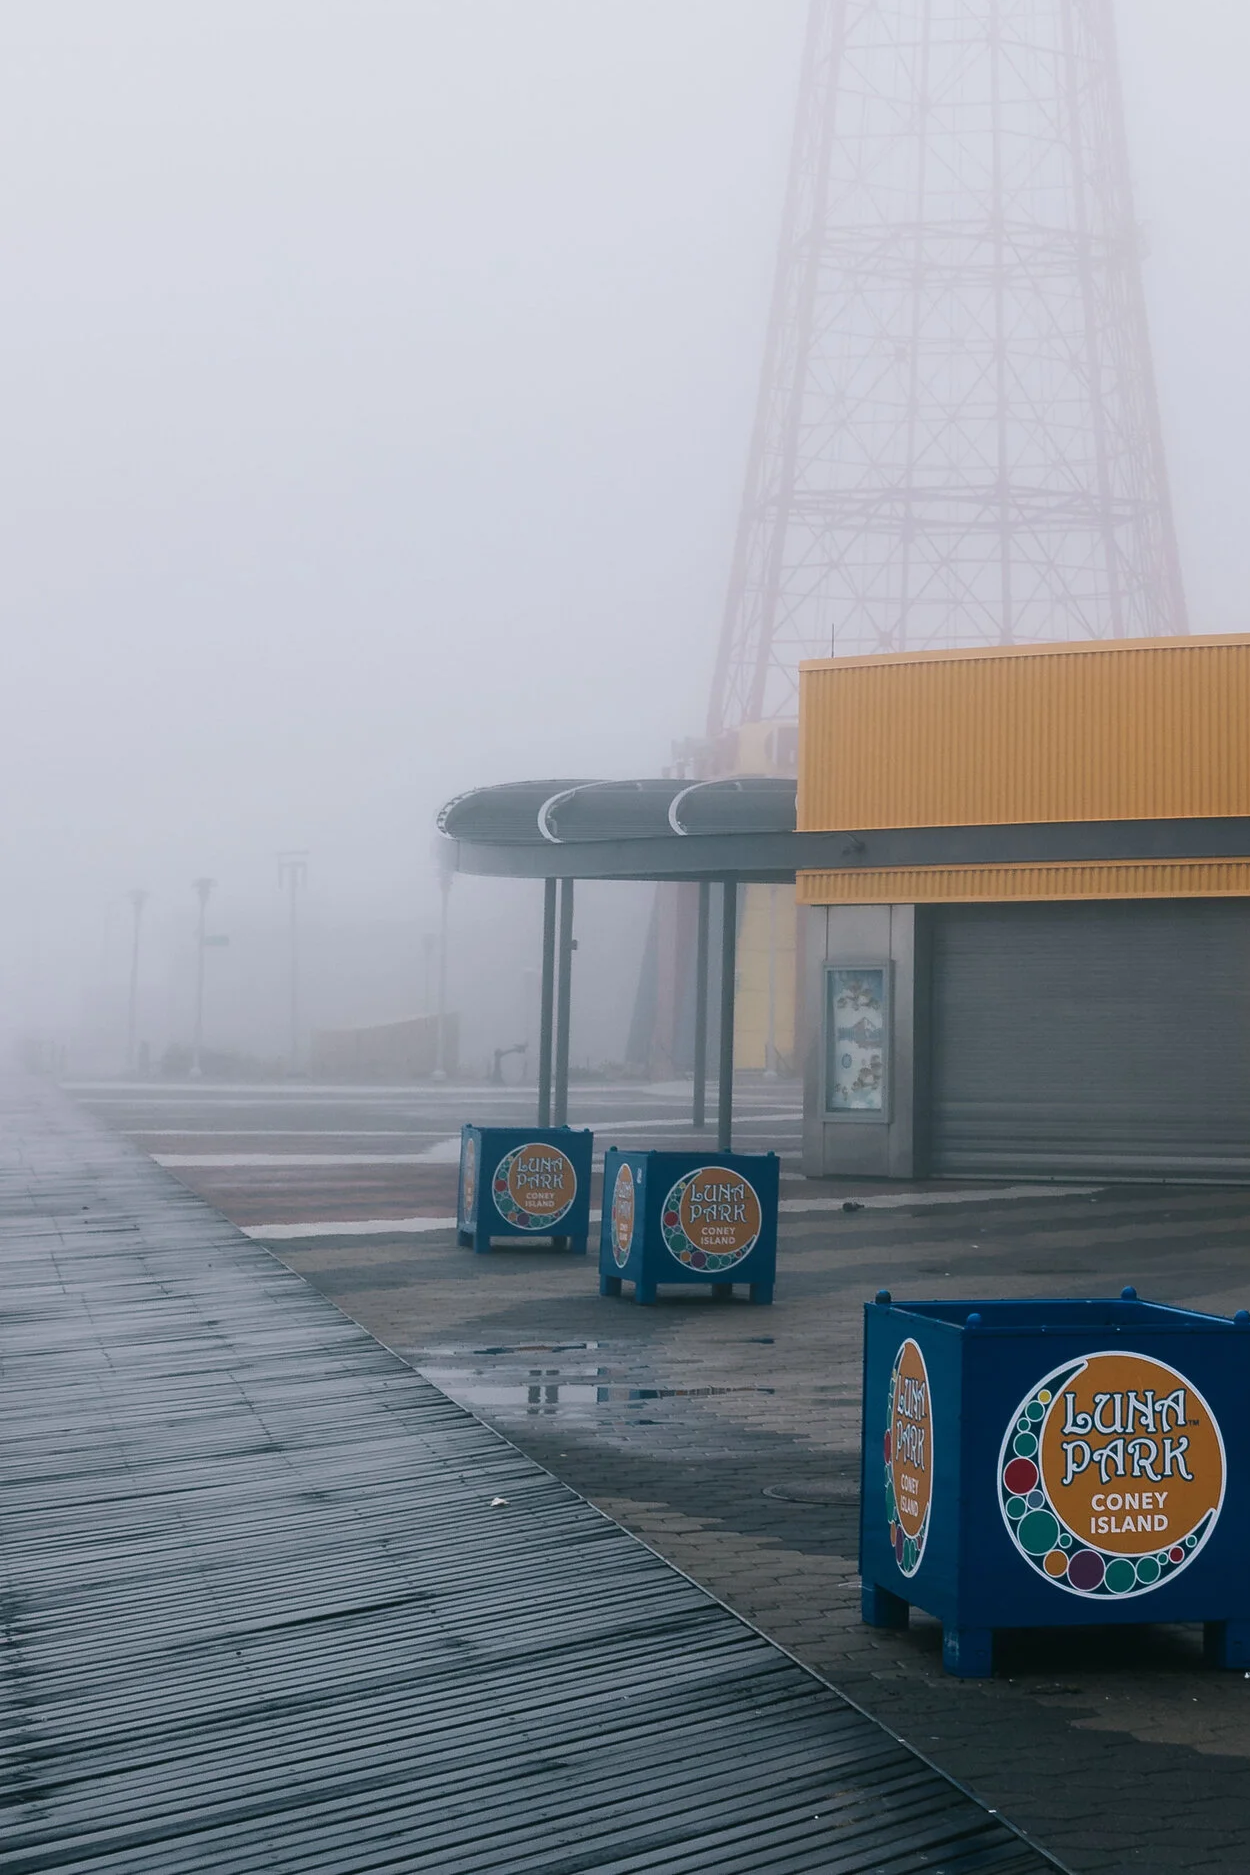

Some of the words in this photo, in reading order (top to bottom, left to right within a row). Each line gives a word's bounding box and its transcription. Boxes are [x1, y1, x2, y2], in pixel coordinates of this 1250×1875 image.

[516, 1156, 564, 1173] LUNA
[515, 1173, 565, 1190] PARK
[526, 1192, 555, 1200] CONEY
[690, 1183, 745, 1203] LUNA
[525, 1200, 556, 1208] ISLAND
[689, 1204, 748, 1223] PARK
[700, 1236, 736, 1245] ISLAND
[701, 1227, 736, 1235] CONEY
[897, 1374, 927, 1422] LUNA
[1061, 1388, 1187, 1435] LUNA
[896, 1419, 925, 1473] PARK
[1061, 1436, 1195, 1485] PARK
[901, 1473, 920, 1495] CONEY
[900, 1498, 919, 1518] ISLAND
[1091, 1491, 1168, 1512] CONEY
[1090, 1514, 1169, 1534] ISLAND
